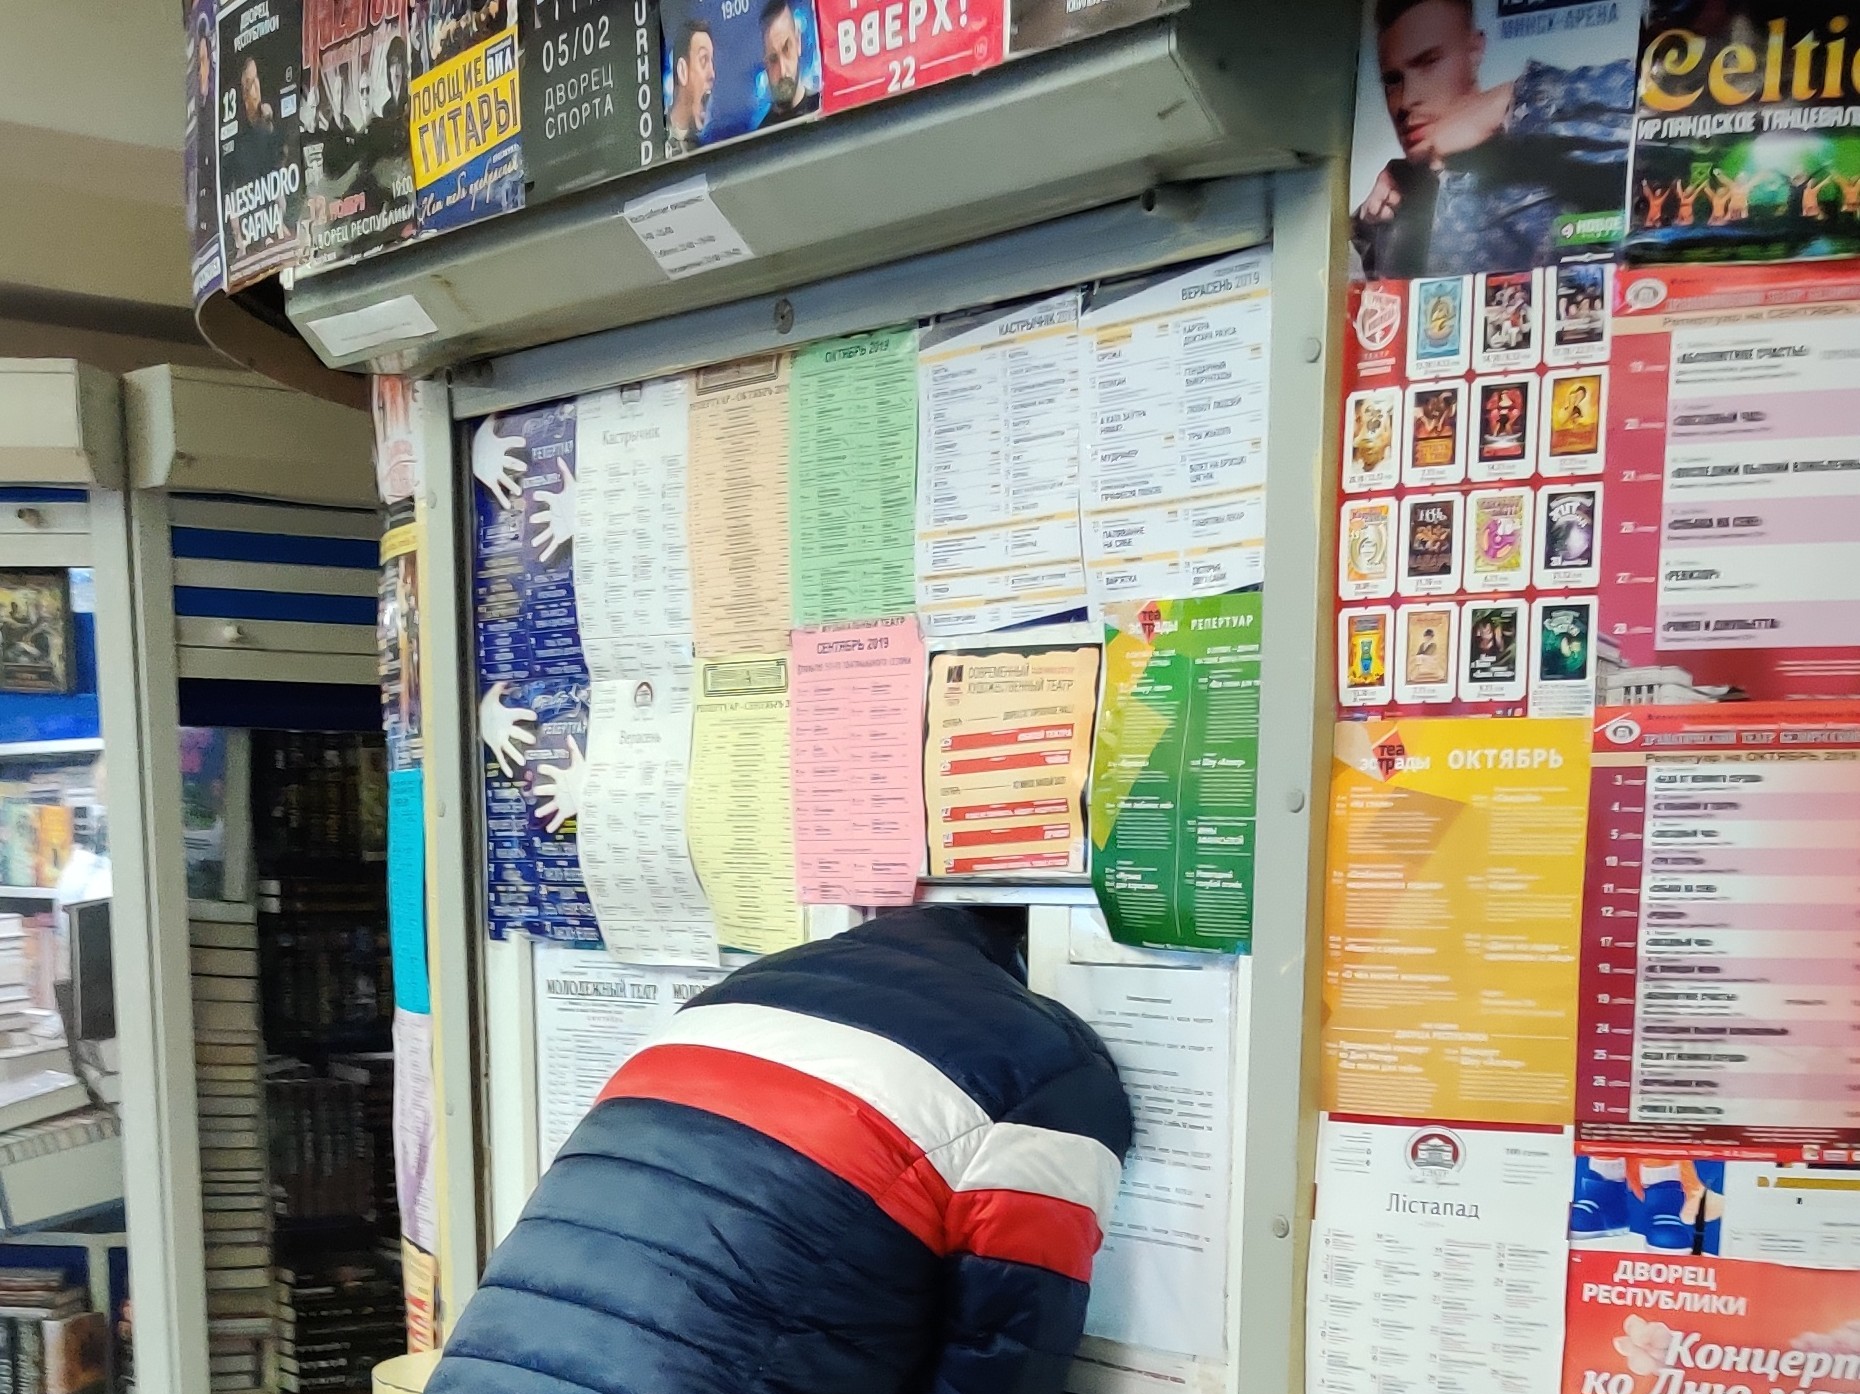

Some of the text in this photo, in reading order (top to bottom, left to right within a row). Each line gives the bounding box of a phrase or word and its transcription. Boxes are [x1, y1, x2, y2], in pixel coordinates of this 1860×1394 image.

[541, 15, 611, 73] 05/02
[411, 56, 483, 122] ПОЮЩИЕ
[543, 63, 614, 115] ДВОРЕЦ
[886, 56, 916, 94] 22
[222, 87, 237, 123] 13
[544, 93, 614, 140] СПОРТА
[417, 77, 519, 174] ГИТАРЫ
[1637, 110, 1755, 141] ИРЛАНДСКОЕ
[224, 162, 300, 222] ALESSANDRO
[241, 203, 283, 246] SAFINA
[1181, 274, 1261, 301] ВЕРАСЕНЬ 2019
[1190, 615, 1254, 631] РЕПЕРТУАР
[867, 636, 889, 650] 2019
[1447, 748, 1565, 770] ОКТЯБРЬ
[1610, 802, 1620, 813] 4
[1610, 829, 1620, 840] 5
[1601, 906, 1615, 917] 12
[1386, 1192, 1480, 1220] Лістапад
[1613, 1260, 1717, 1290] ДВОРЕЦ
[1582, 1283, 1749, 1316] РЕСПУБЛИКИ
